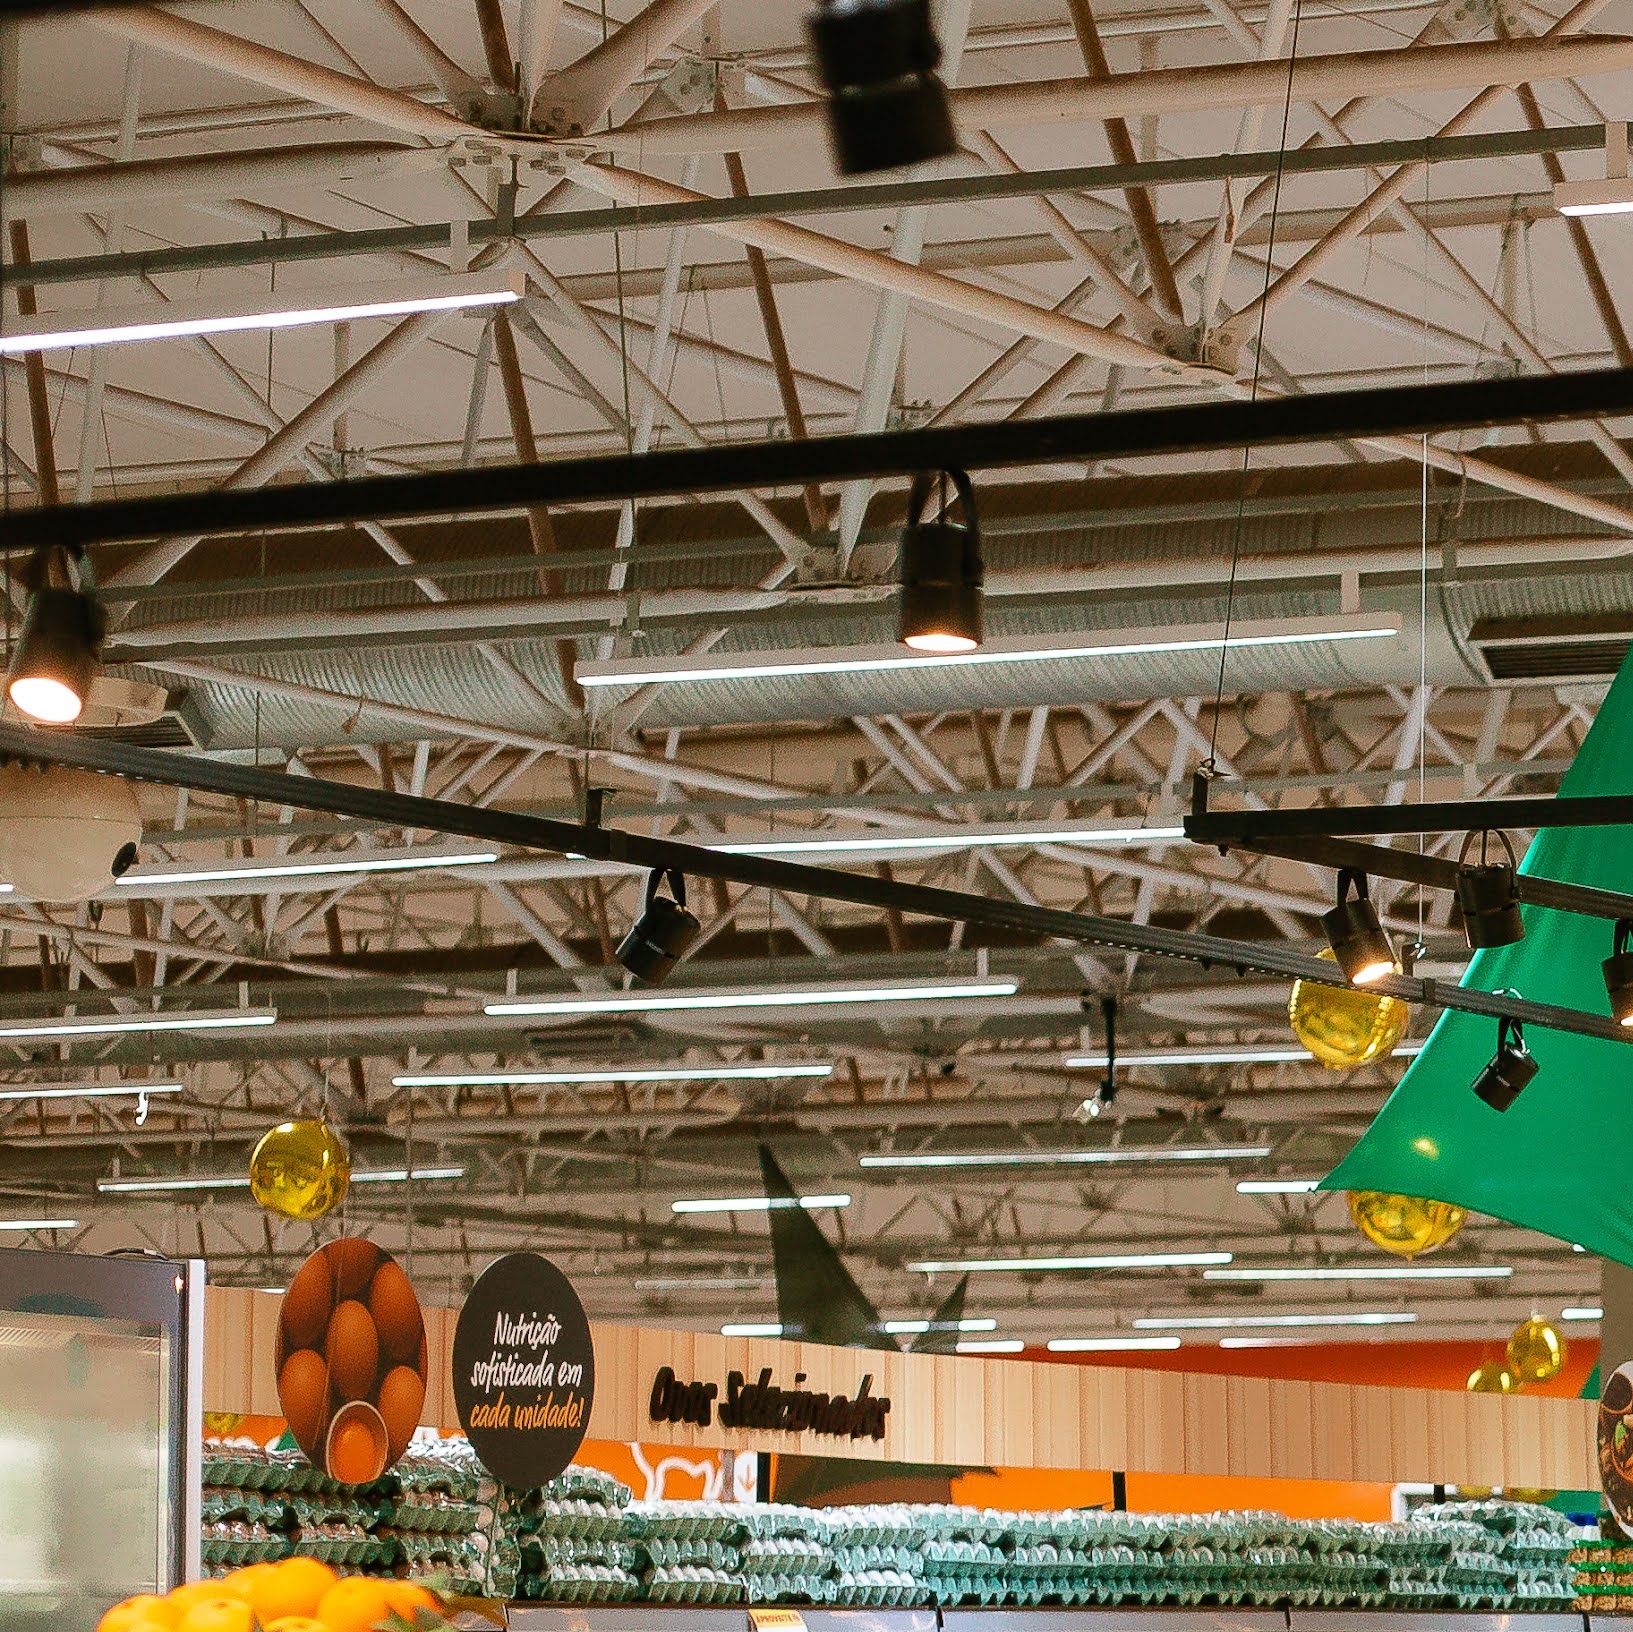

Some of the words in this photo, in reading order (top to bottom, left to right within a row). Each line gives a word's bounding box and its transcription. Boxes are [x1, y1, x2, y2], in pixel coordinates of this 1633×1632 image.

[493, 1311, 562, 1350] Nutrição
[470, 1348, 553, 1398] sofisticada
[557, 1362, 583, 1389] em
[470, 1391, 511, 1429] cada
[513, 1390, 585, 1430] unidade!
